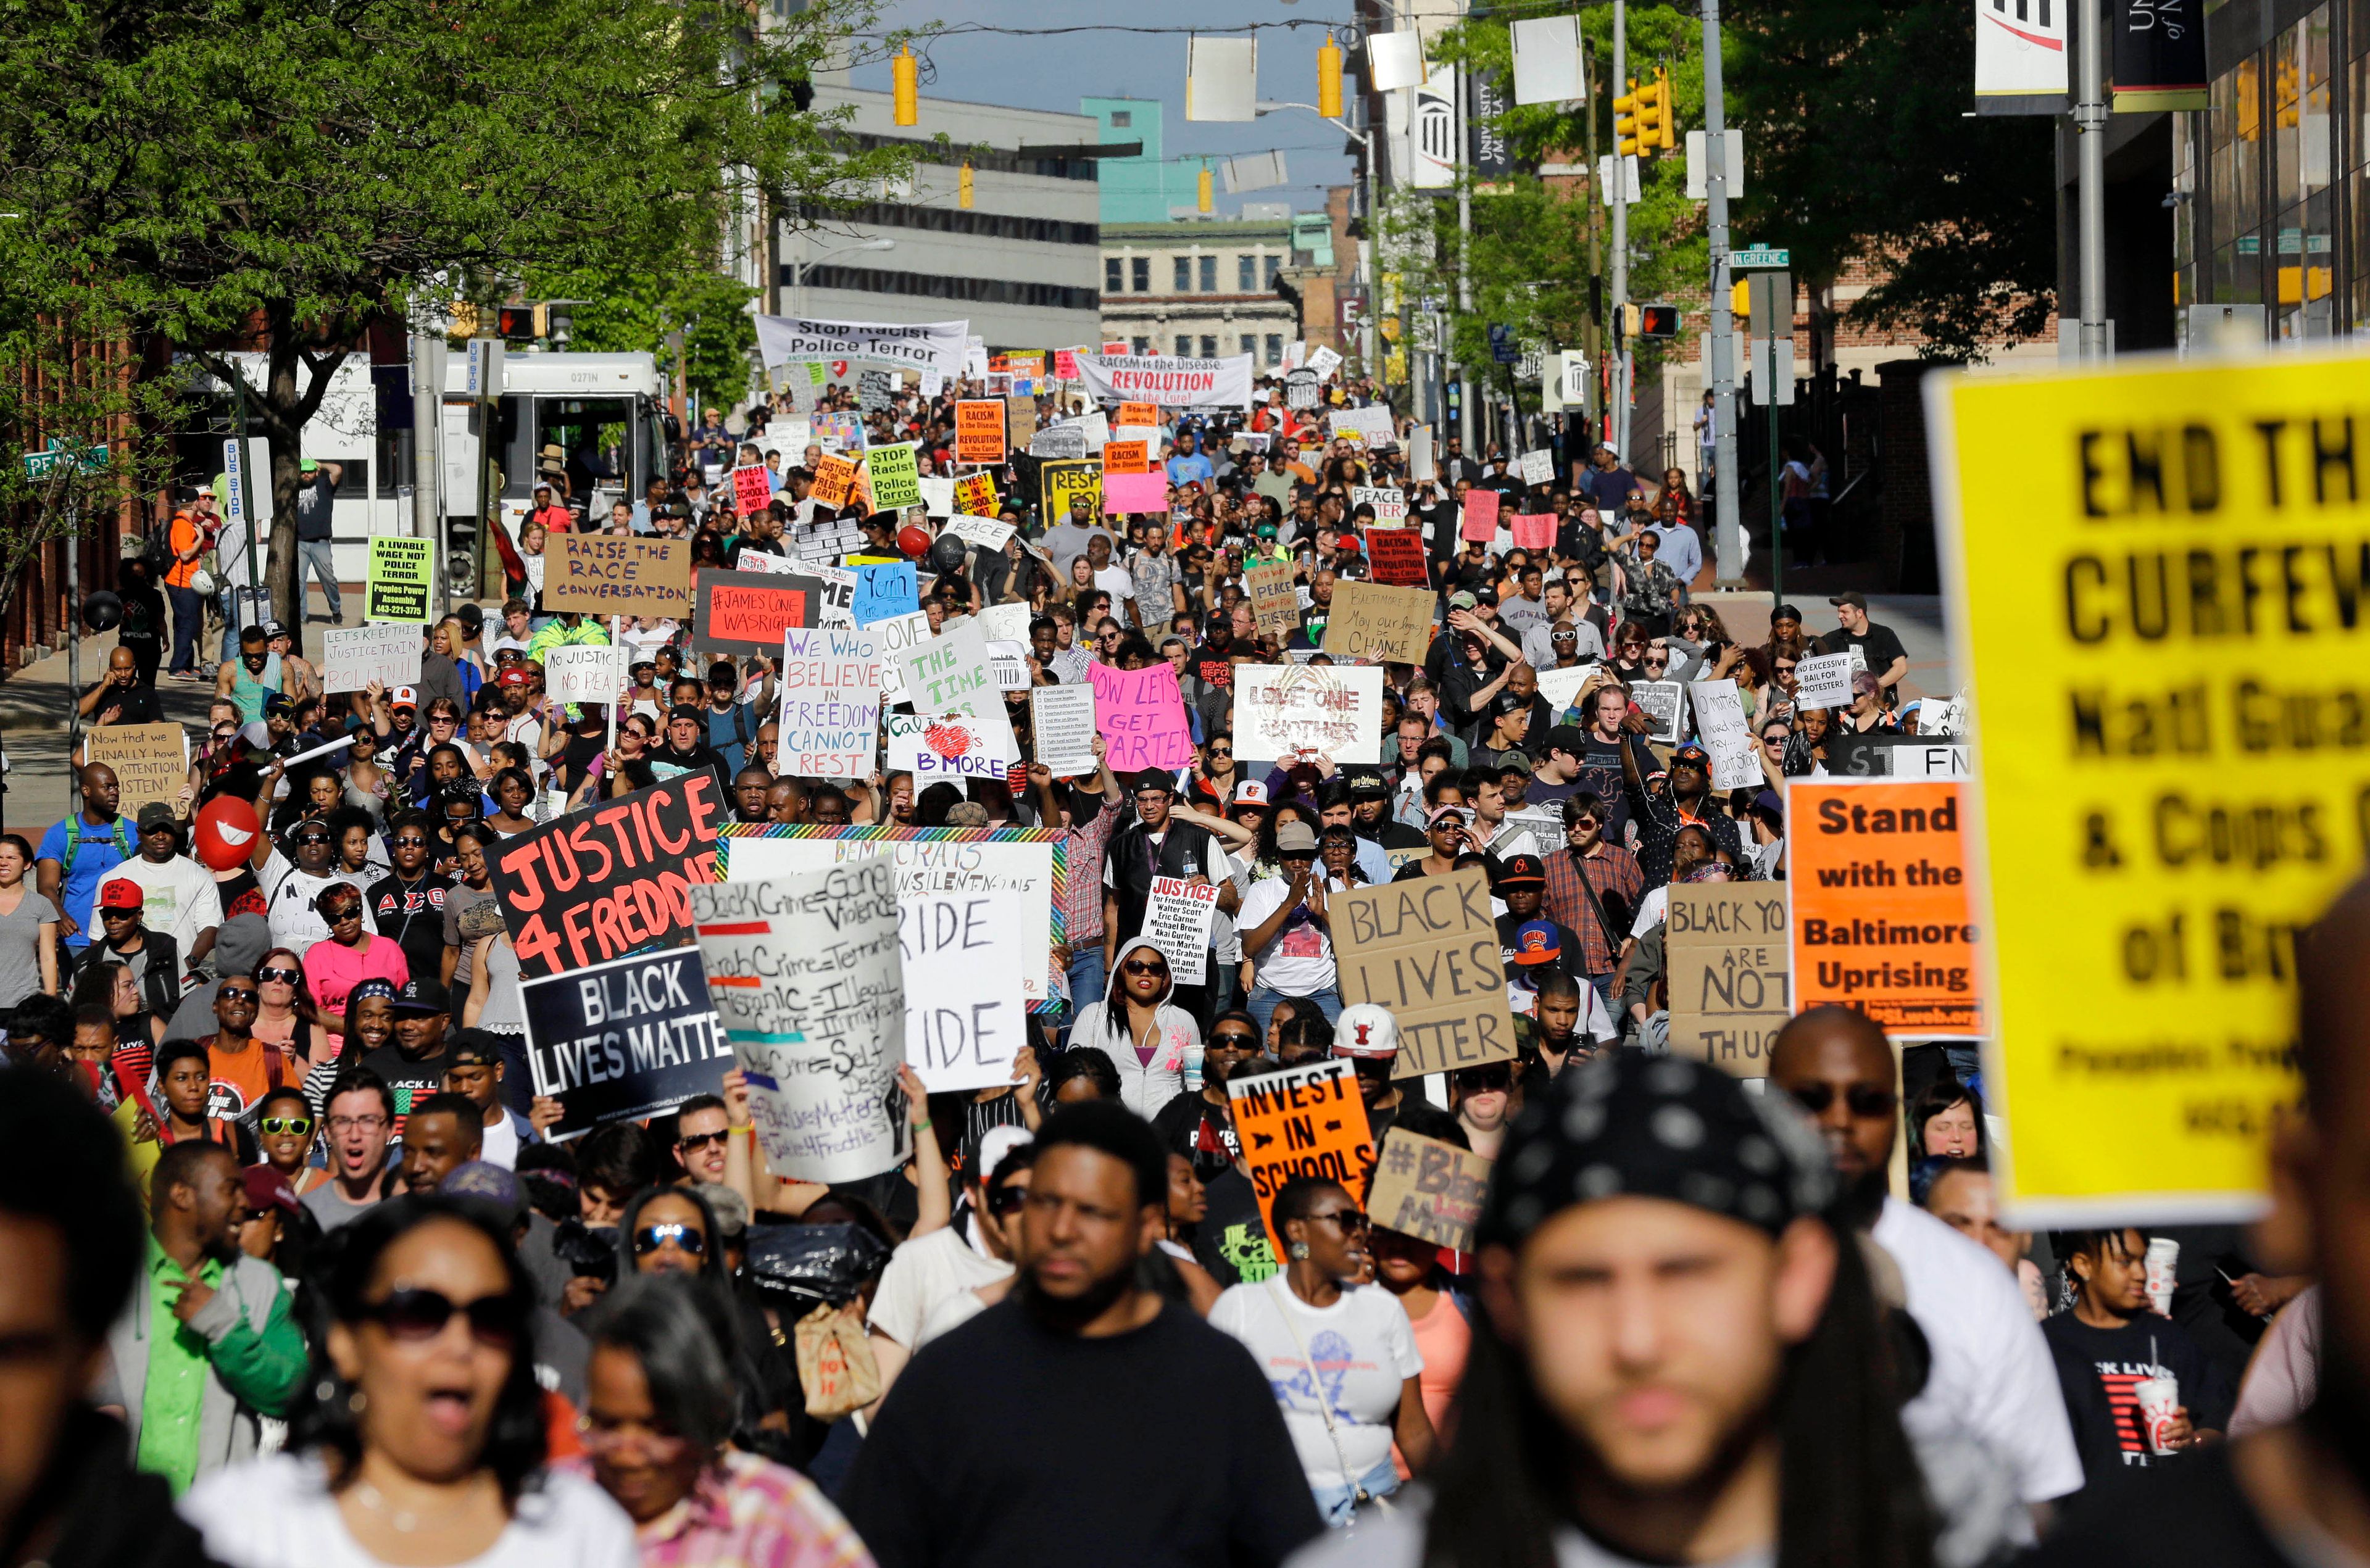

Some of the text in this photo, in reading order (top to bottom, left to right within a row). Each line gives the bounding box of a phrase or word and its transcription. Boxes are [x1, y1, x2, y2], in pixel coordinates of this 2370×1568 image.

[2162, 17, 2185, 39] of
[1480, 83, 1492, 160] UNIVSITY
[1736, 253, 1781, 265] N GREENE
[799, 321, 850, 336] Stop
[791, 339, 938, 363] Police Terror
[1099, 357, 1173, 370] RACISM the
[1112, 370, 1215, 391] REVOLUTION
[1144, 391, 1160, 402] the
[966, 411, 994, 420] RACISM
[1126, 405, 1153, 413] Stand
[959, 434, 1002, 443] REVOLUTION
[228, 444, 237, 473] BUS
[873, 449, 907, 463] STOP
[1112, 450, 1139, 460] RACISM
[735, 466, 764, 478] INVEST
[819, 461, 852, 478] JUSTICE
[872, 462, 915, 476] Racist
[2077, 422, 2221, 520] END
[747, 477, 754, 487] IN
[815, 476, 847, 494] FREDDIE
[875, 478, 917, 491] Police
[957, 475, 988, 489] INVEST
[230, 477, 240, 517] STOP
[736, 486, 770, 499] SCHOOLS
[815, 487, 837, 501] GRAY
[876, 488, 918, 500] Terror
[971, 487, 981, 498] IN
[1353, 489, 1402, 504] PEACE
[746, 499, 762, 508] NOT
[962, 494, 997, 512] SCHOOLS
[954, 523, 1006, 538] RACE
[378, 541, 425, 550] A LIVABLE
[567, 539, 672, 561] RAISE THE
[800, 542, 821, 550] OTHER
[1376, 538, 1412, 547] RACISM
[376, 550, 426, 560] WAGE NOT
[803, 549, 830, 558] NOTHING
[383, 560, 417, 570] POLICE
[568, 560, 639, 580] RACE
[1372, 559, 1424, 570] REVOLUTION
[382, 570, 418, 580] TERROR
[864, 566, 907, 599] Youth
[1249, 574, 1257, 583] IF
[374, 584, 426, 596] Peoples Power
[1257, 581, 1291, 599] PEACE
[382, 594, 416, 606] Assembly
[1279, 597, 1292, 608] FOR
[375, 605, 422, 616] 443-221-3775
[1258, 608, 1297, 628] JUSTICE
[724, 612, 801, 633] WASRIGHT
[1307, 617, 1325, 626] ONE
[1345, 610, 1424, 637] May legacy
[327, 628, 360, 644] LET'S
[1377, 629, 1389, 637] be
[329, 641, 417, 660] JUSTICE TRAIN
[1349, 631, 1409, 658] CHANGE
[549, 652, 562, 667] NO
[910, 642, 957, 681] THE
[1795, 658, 1848, 675] END EXCESSIVE
[562, 672, 578, 691] NO
[787, 662, 881, 689] BELIEVE
[1804, 671, 1836, 683] BAIL FOR
[926, 665, 988, 705] TIME
[1087, 670, 1180, 705] NOW LET'S
[1800, 680, 1844, 694] PROTESTERS
[824, 689, 840, 702] IN
[1249, 686, 1306, 708] LOVE
[1313, 689, 1360, 711] ONE
[783, 700, 878, 729] FREEDOM
[1107, 713, 1161, 732] GET
[1730, 719, 1746, 732] you
[91, 731, 167, 745] Now that we
[788, 730, 872, 752] CANNOT
[94, 748, 178, 761] FINALLY have
[1599, 755, 1618, 765] CLOWN
[1736, 751, 1758, 771] Stop
[119, 762, 184, 775] ATTENTION,
[799, 753, 865, 775] REST
[1350, 774, 1381, 787] New Orleans
[1718, 774, 1748, 787] us now
[1818, 797, 1958, 836] Stand
[2152, 790, 2328, 871] Cops
[501, 774, 717, 912] JUSTICE
[835, 841, 983, 871] DEMOCRATS
[1818, 860, 1963, 887] with the
[1153, 877, 1217, 902] JUSTICE
[691, 883, 759, 921] Black
[1154, 895, 1210, 911] for Freddie Gray
[1157, 903, 1202, 917] Walter Scott
[823, 895, 898, 932] Violence
[1158, 912, 1197, 924] Eric Garner
[1348, 879, 1492, 944] BLACK
[1671, 900, 1752, 934] BLACK
[1150, 919, 1203, 934] Michael Brown
[1803, 919, 1981, 946] Baltimore
[515, 913, 566, 974] 4
[1155, 929, 1196, 943] Akai Gurley
[1177, 940, 1202, 950] Martin
[1176, 948, 1204, 960] Graham
[1722, 948, 1769, 969] ARE
[1172, 966, 1204, 976] others...
[1182, 959, 1196, 968] and
[1360, 941, 1502, 1008] LIVES
[1817, 961, 1969, 993] Uprising
[578, 960, 691, 1027] BLACK
[1700, 964, 1789, 1011] NOT
[1397, 1013, 1510, 1074] ATTER
[534, 1031, 625, 1097] LIVES
[627, 1011, 734, 1074] MATTE
[1238, 1066, 1347, 1120] INVEST
[1284, 1113, 1316, 1152] IN
[1250, 1143, 1376, 1199] SCHOOLS
